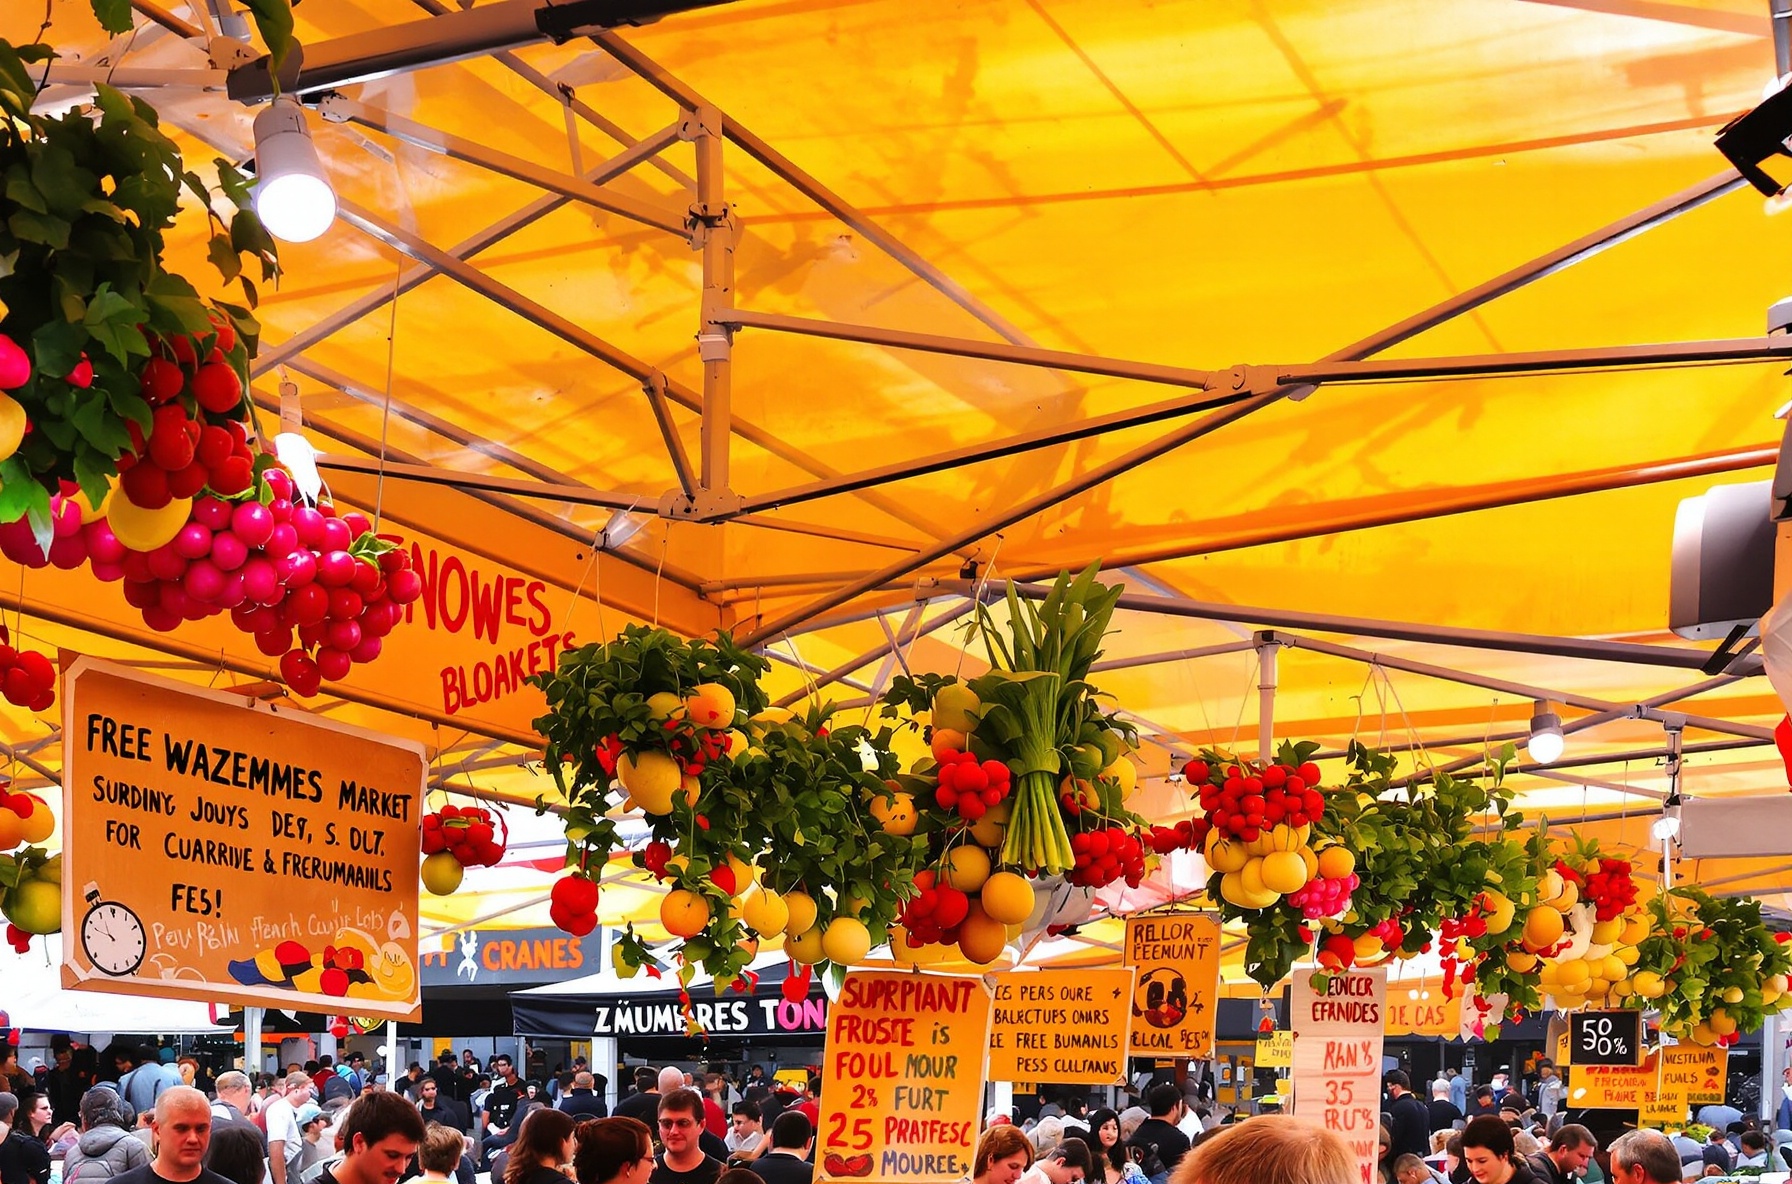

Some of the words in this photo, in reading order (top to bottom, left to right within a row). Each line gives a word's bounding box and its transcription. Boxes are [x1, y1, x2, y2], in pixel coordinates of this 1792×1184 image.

[87, 713, 152, 762] FREE
[164, 733, 323, 803] WAZEMMES
[338, 780, 412, 823] MARKET
[190, 796, 249, 830] JOUYS
[106, 819, 142, 851] FOR
[171, 883, 223, 918] FES!
[482, 937, 584, 971] CRANES
[1060, 986, 1094, 1002] OURE
[931, 1021, 951, 1045] is
[1016, 1032, 1049, 1049] FREE
[836, 1051, 899, 1080] FOUL
[904, 1053, 958, 1079] MOUR
[1017, 1057, 1049, 1073] PESS
[850, 1083, 879, 1109] 2%
[894, 1085, 950, 1111] FURT
[1325, 1080, 1355, 1106] 35
[826, 1112, 873, 1150] 25
